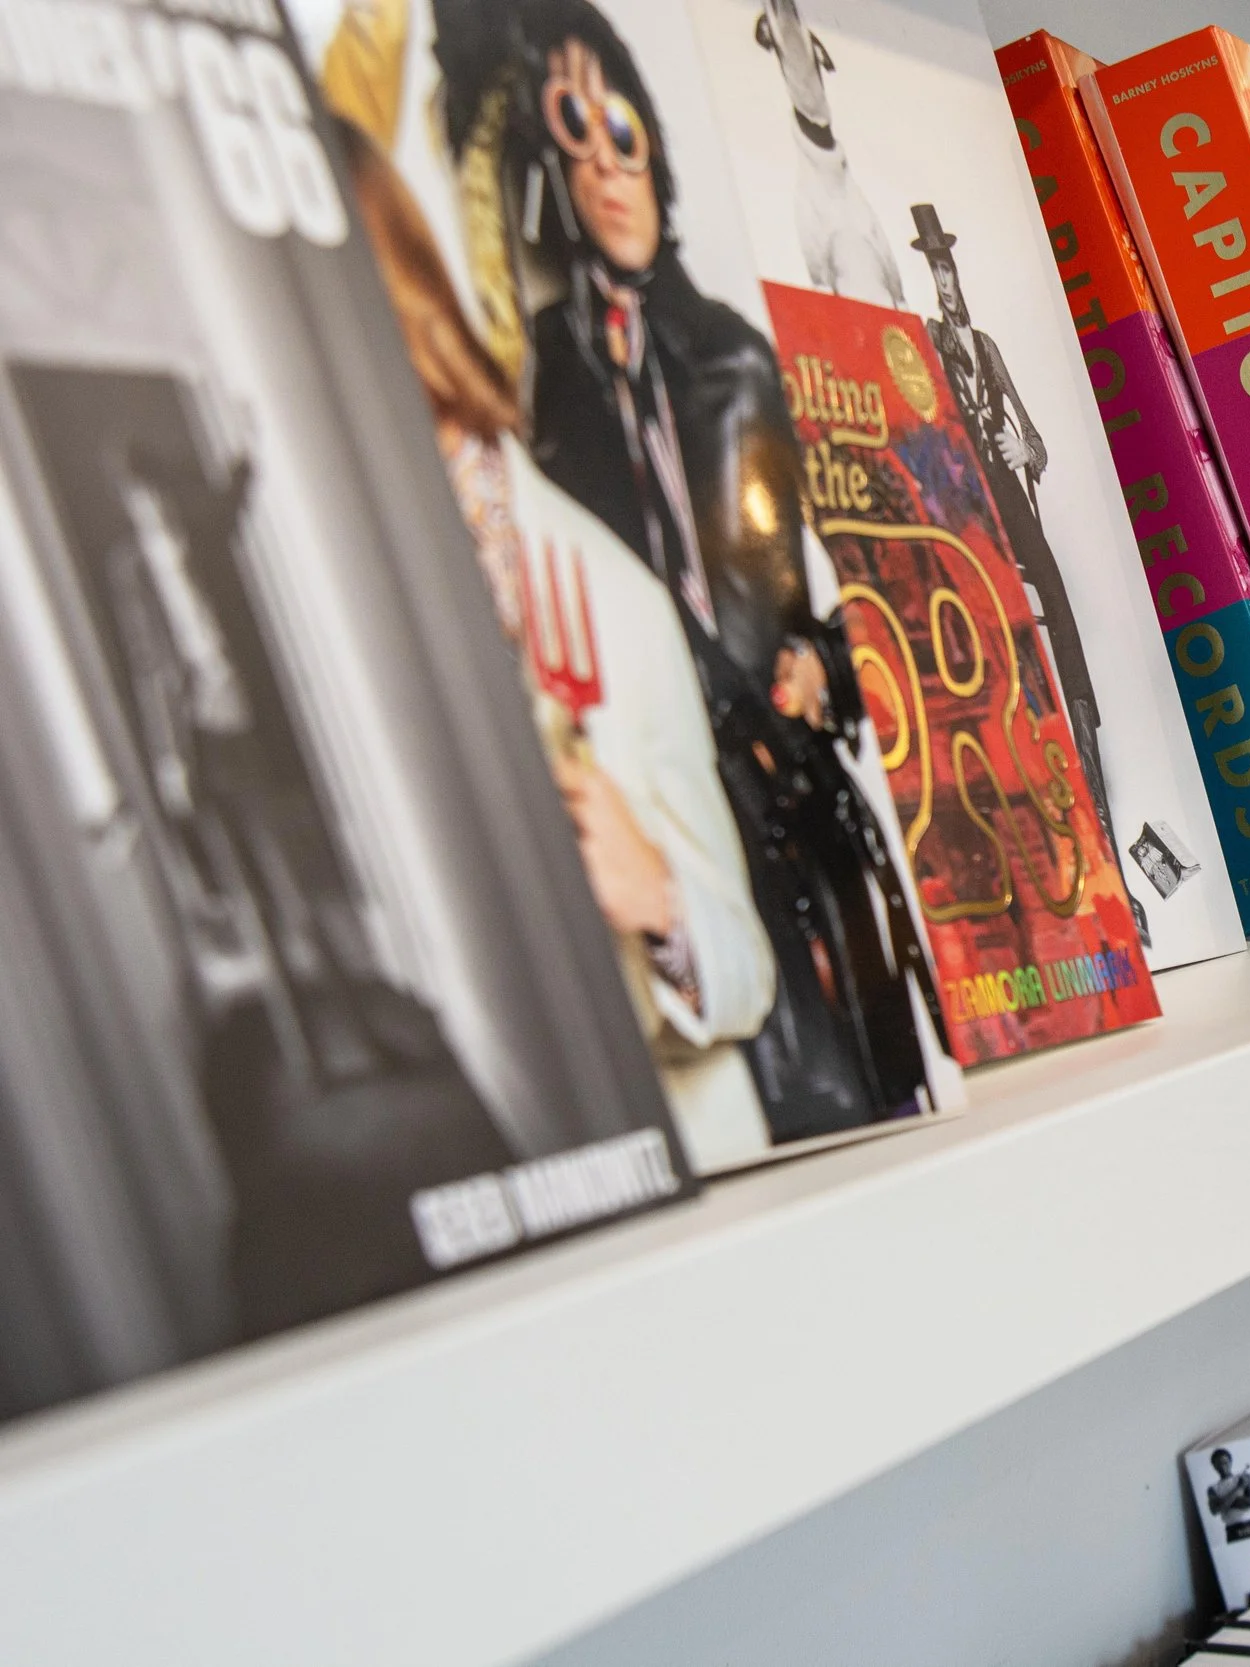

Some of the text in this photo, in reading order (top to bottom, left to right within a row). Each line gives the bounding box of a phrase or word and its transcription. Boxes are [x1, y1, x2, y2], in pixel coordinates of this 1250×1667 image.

[1112, 55, 1219, 105] BARNEY HOSKYNS
[782, 354, 889, 450] olling
[803, 439, 872, 512] the
